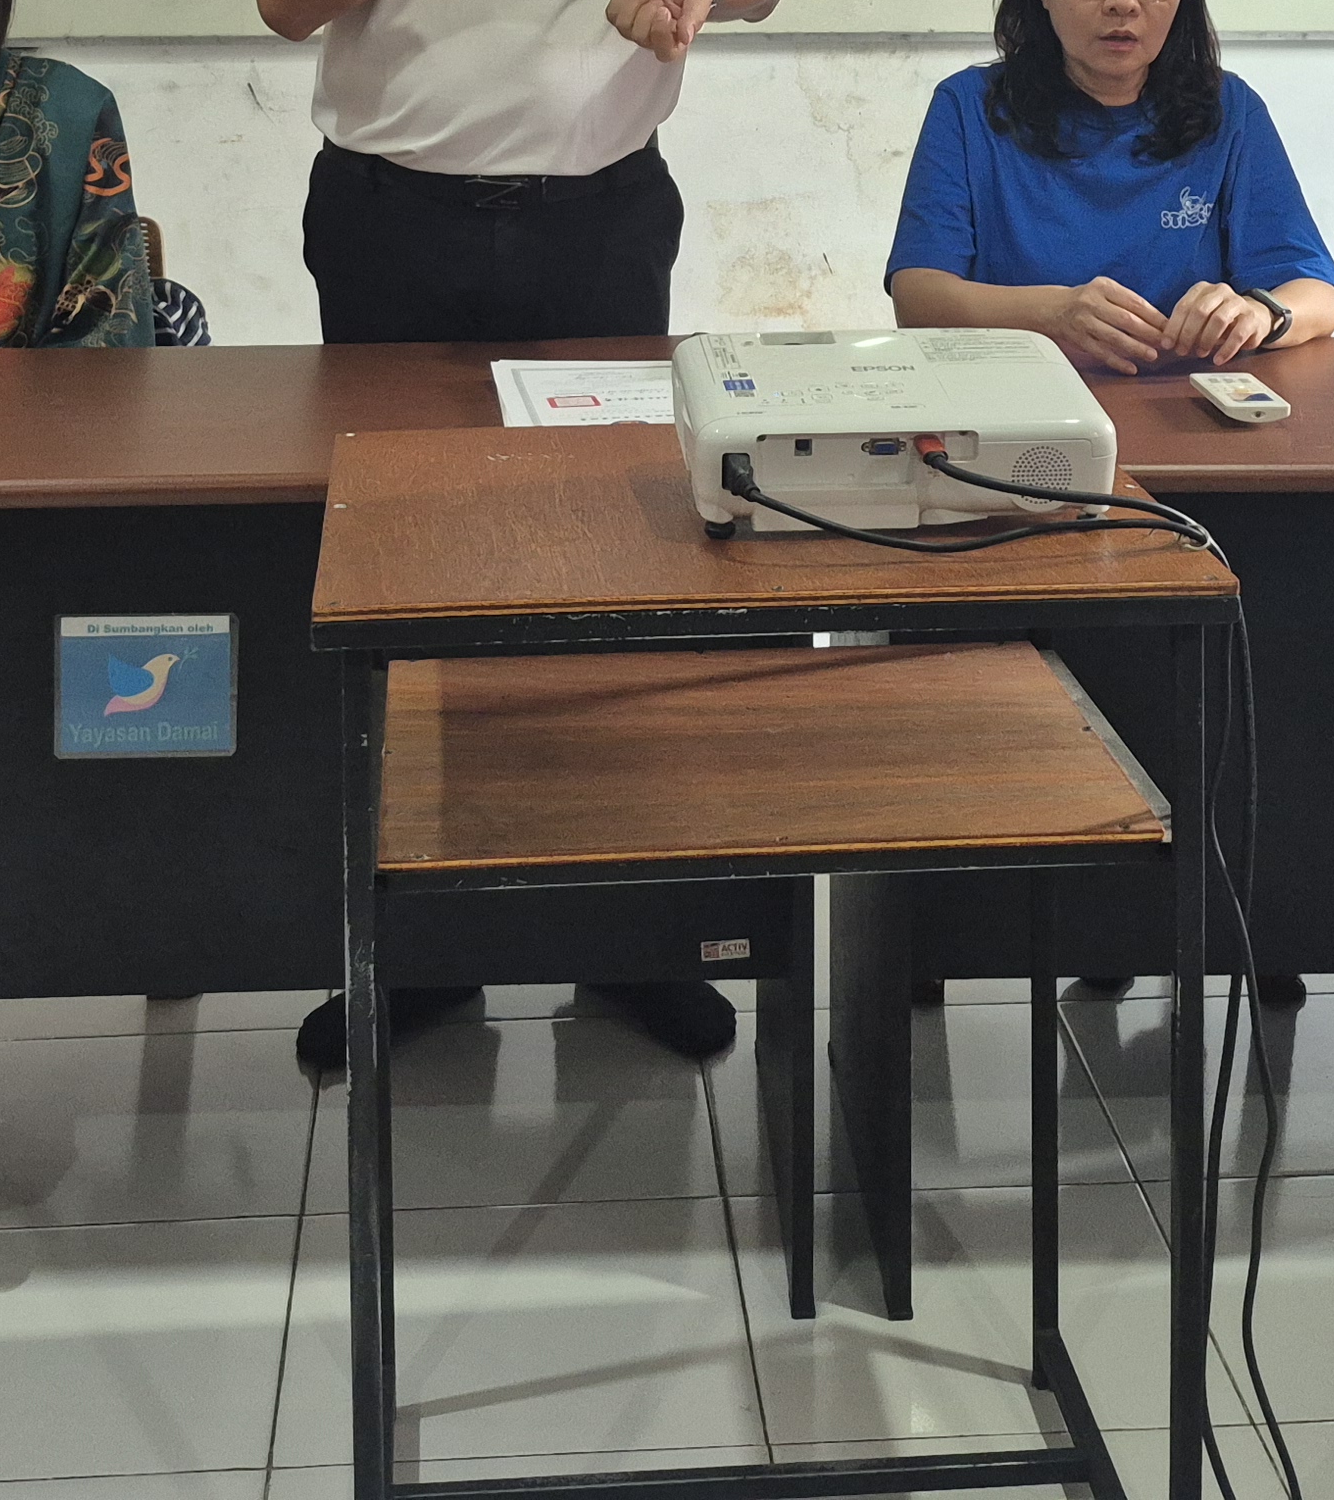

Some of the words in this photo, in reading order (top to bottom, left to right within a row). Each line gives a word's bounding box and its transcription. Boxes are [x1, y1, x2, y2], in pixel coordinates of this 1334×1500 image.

[87, 624, 100, 634] Di
[104, 623, 184, 636] Sumbangkan
[187, 623, 214, 633] oleh
[70, 723, 151, 747] Yayasan
[158, 721, 218, 740] Damai
